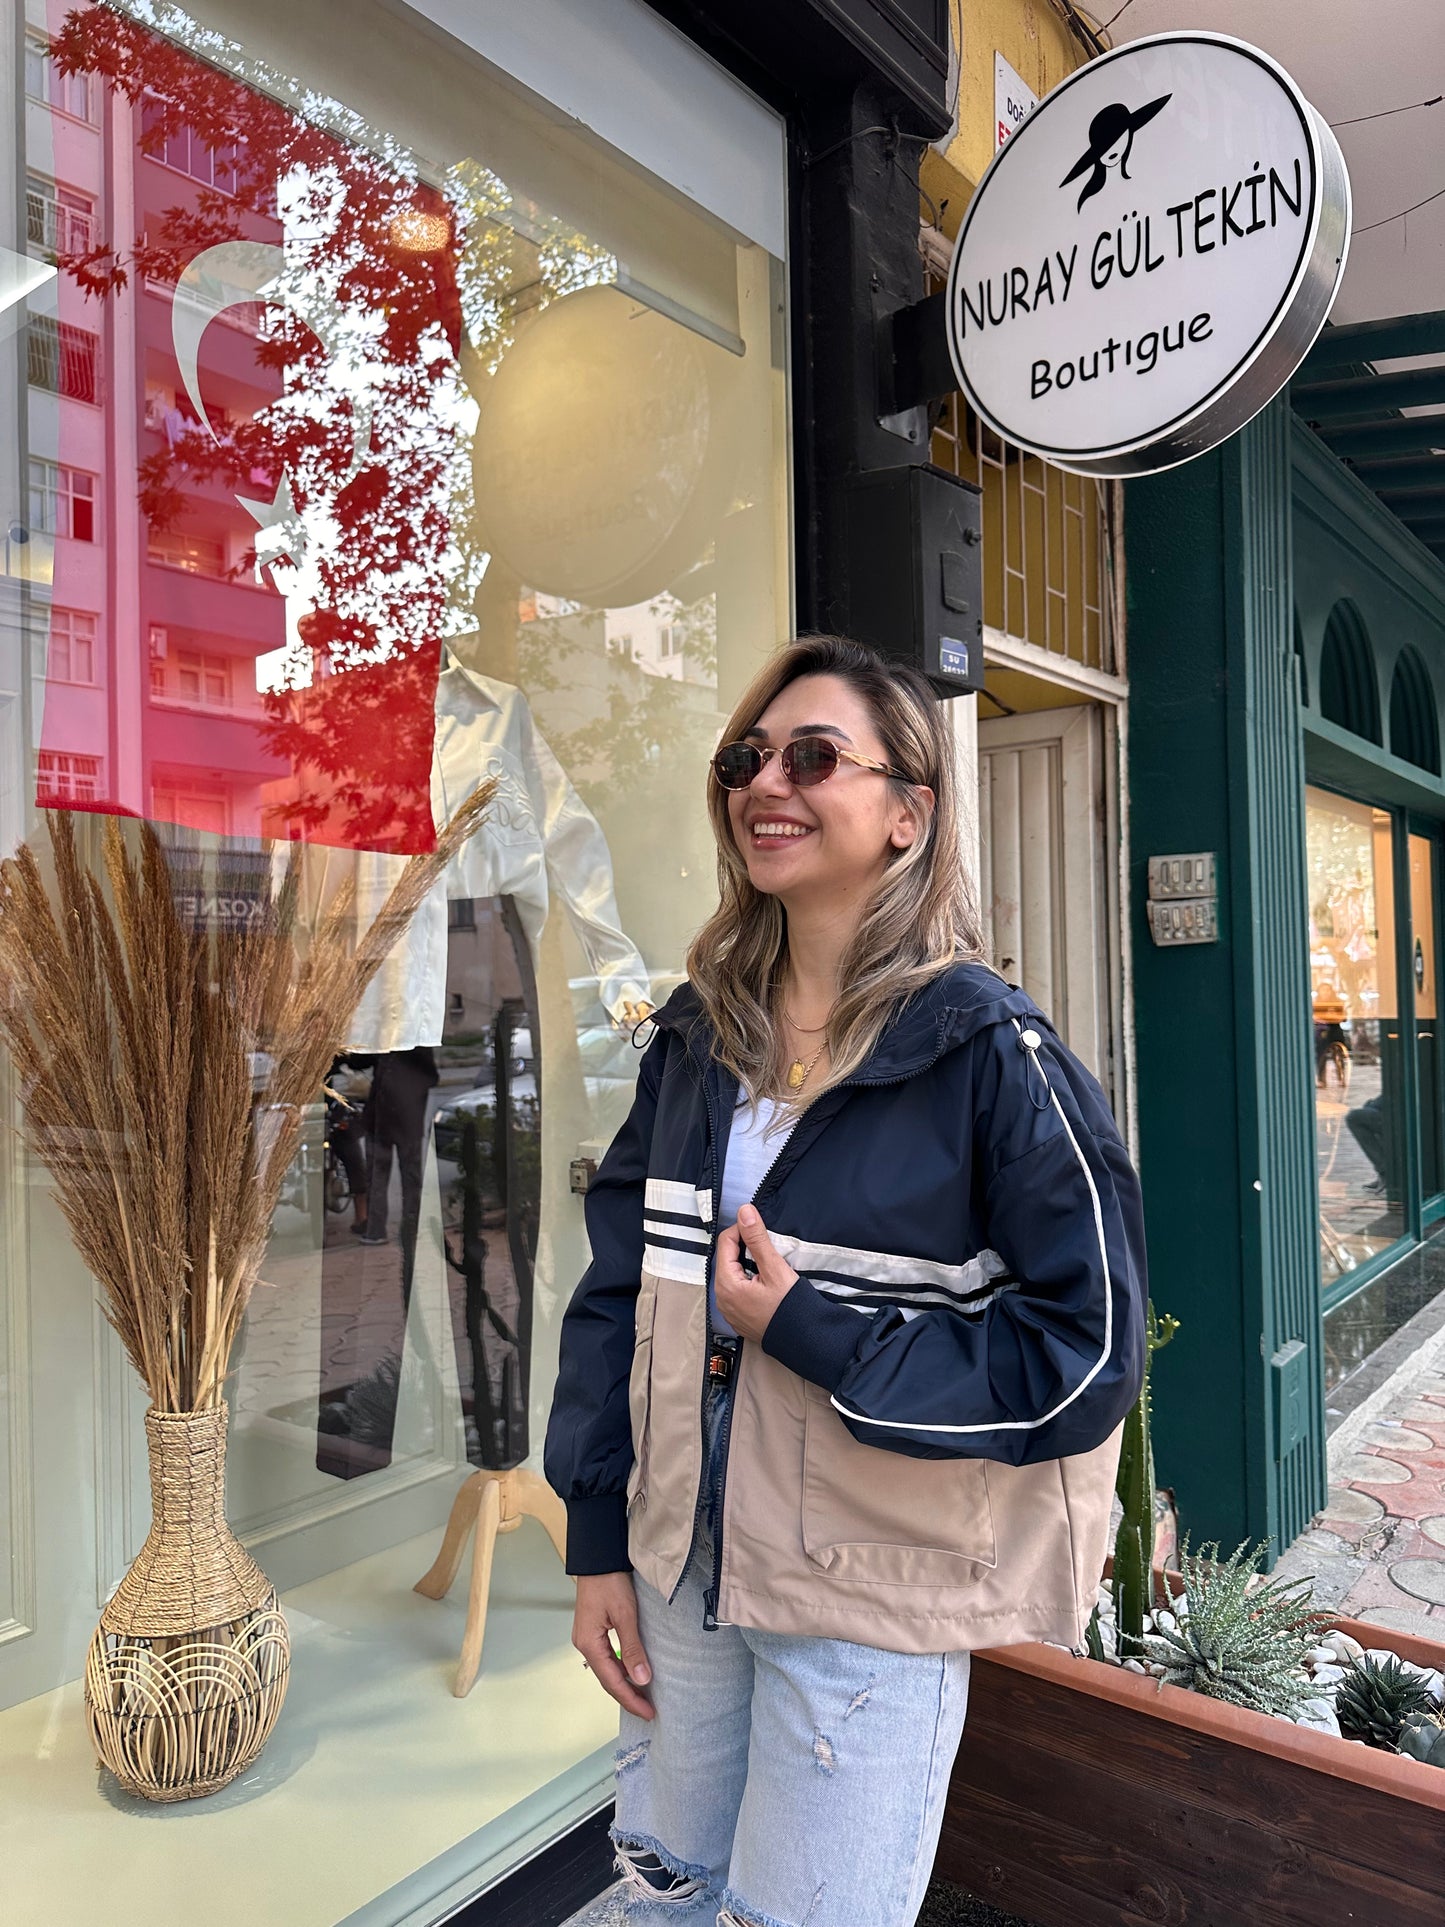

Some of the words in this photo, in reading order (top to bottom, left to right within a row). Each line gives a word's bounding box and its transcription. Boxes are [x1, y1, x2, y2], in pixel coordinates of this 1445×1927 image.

[961, 245, 1078, 339] NURAY
[1090, 158, 1302, 289] GÜLTEKİN
[949, 654, 960, 664] SU
